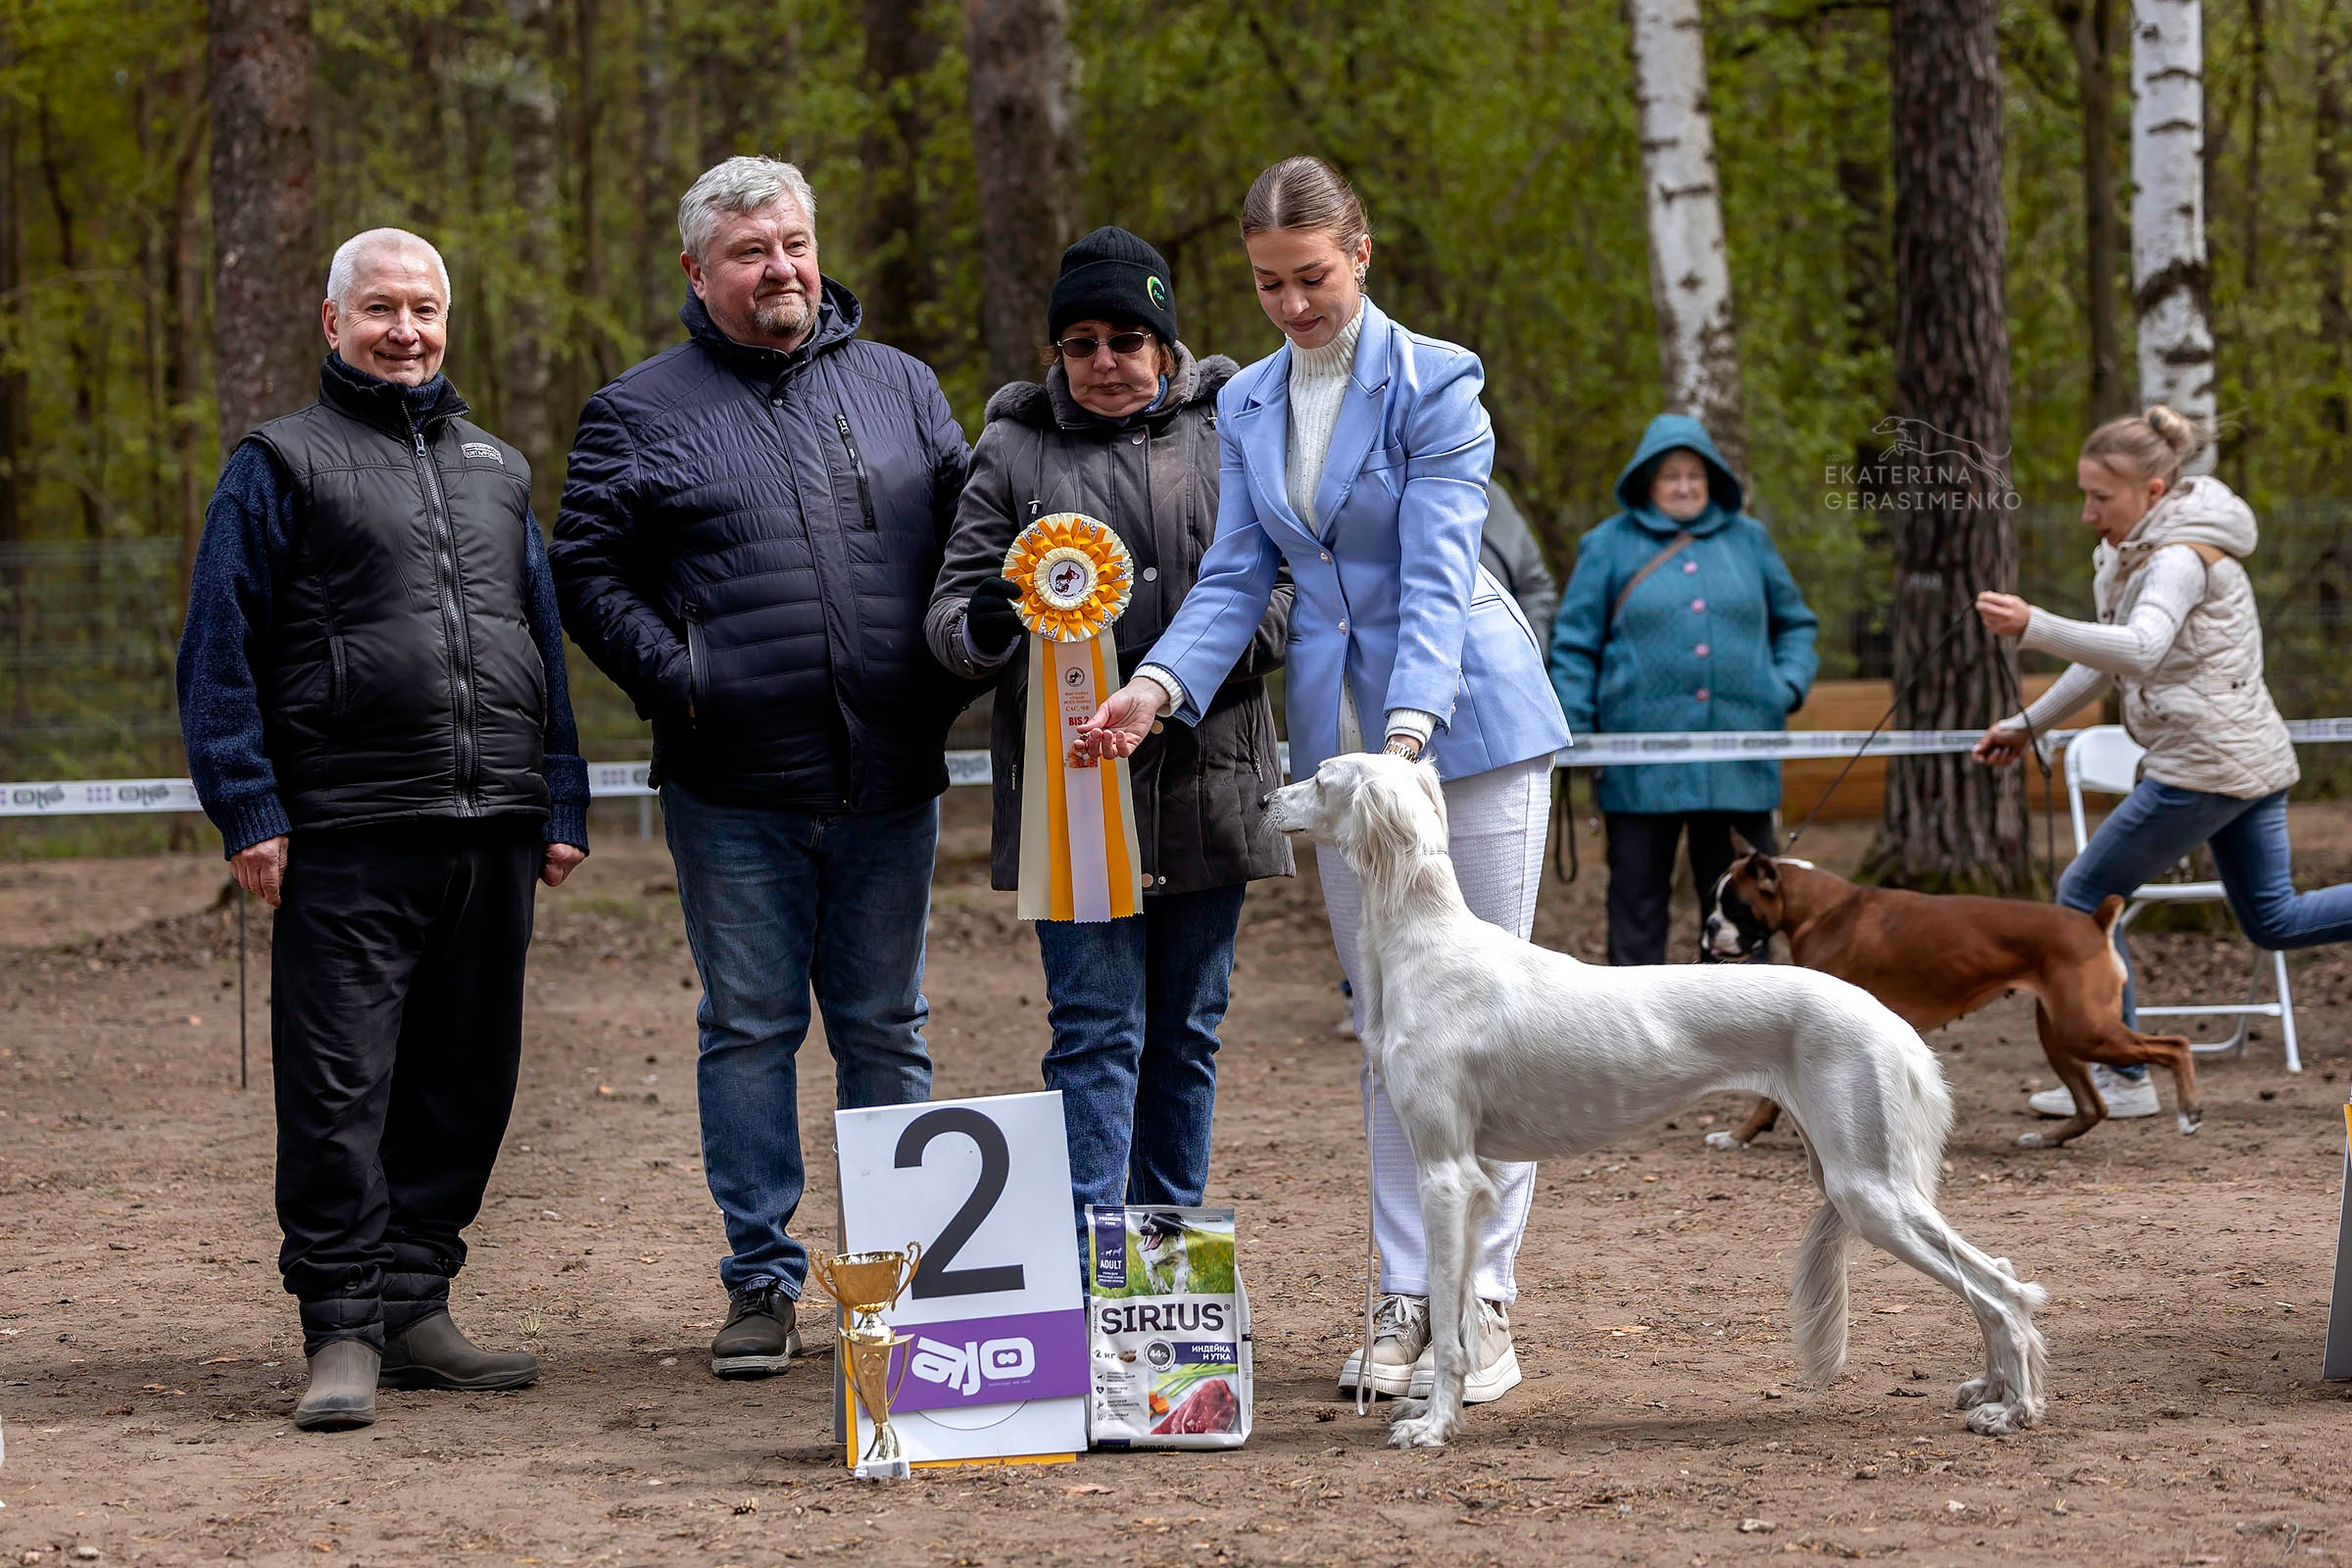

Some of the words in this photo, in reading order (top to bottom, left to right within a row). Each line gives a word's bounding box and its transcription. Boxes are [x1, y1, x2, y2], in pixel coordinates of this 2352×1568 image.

[1068, 716, 1083, 725] BIS
[894, 1107, 1025, 1299] 2
[1100, 1259, 1122, 1270] ADULT
[1102, 1303, 1224, 1335] SIRIUS
[1149, 1348, 1168, 1358] 44%
[1192, 1344, 1231, 1353] ИНДЕЙКА
[1211, 1352, 1232, 1361] УТКА
